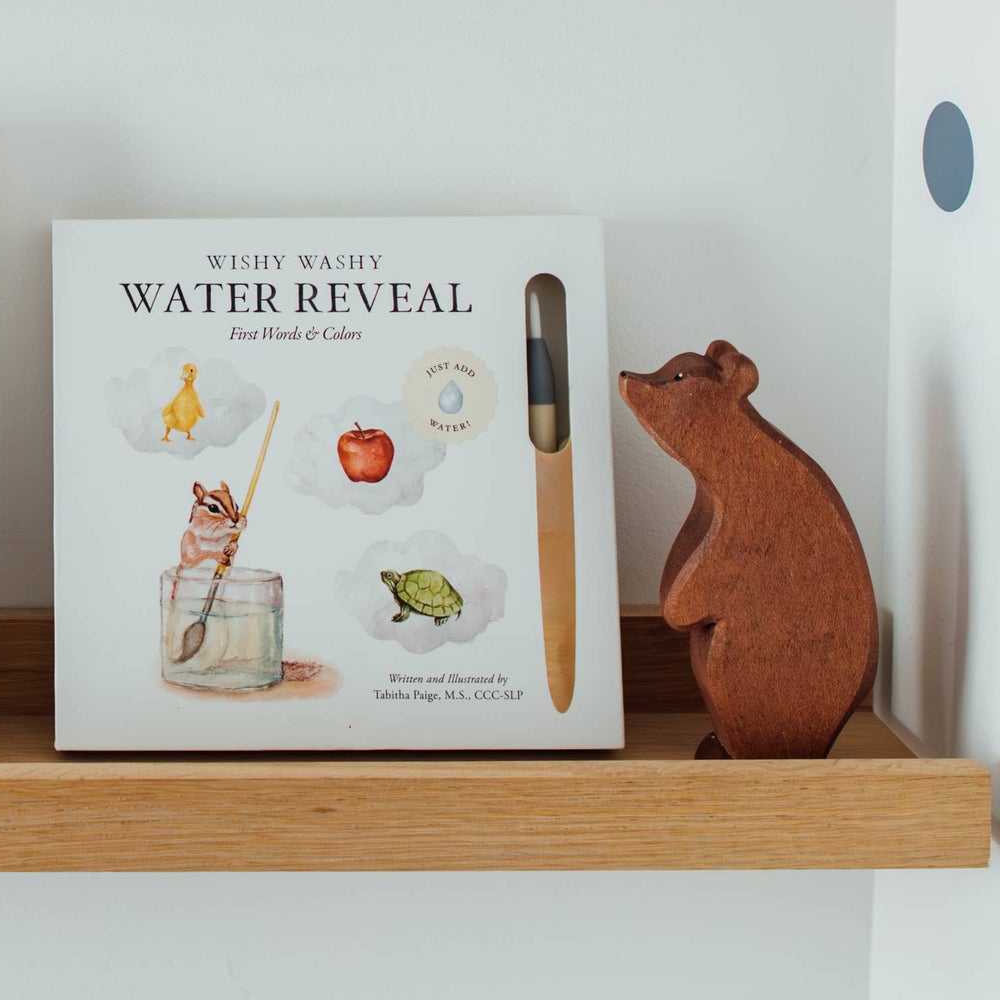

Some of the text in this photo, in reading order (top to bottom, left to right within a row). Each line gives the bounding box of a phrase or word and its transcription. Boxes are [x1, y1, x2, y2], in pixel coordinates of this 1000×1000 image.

[207, 255, 383, 270] WISHY WASHY
[119, 283, 472, 313] WATER REVEAL
[229, 326, 362, 341] First Words & Colors
[426, 362, 476, 378] JUST ADD
[430, 418, 471, 432] WATER!
[389, 673, 508, 687] Written and Illustrated by
[373, 689, 524, 702] Tabitha Paige, M.S., CCC-SLP
